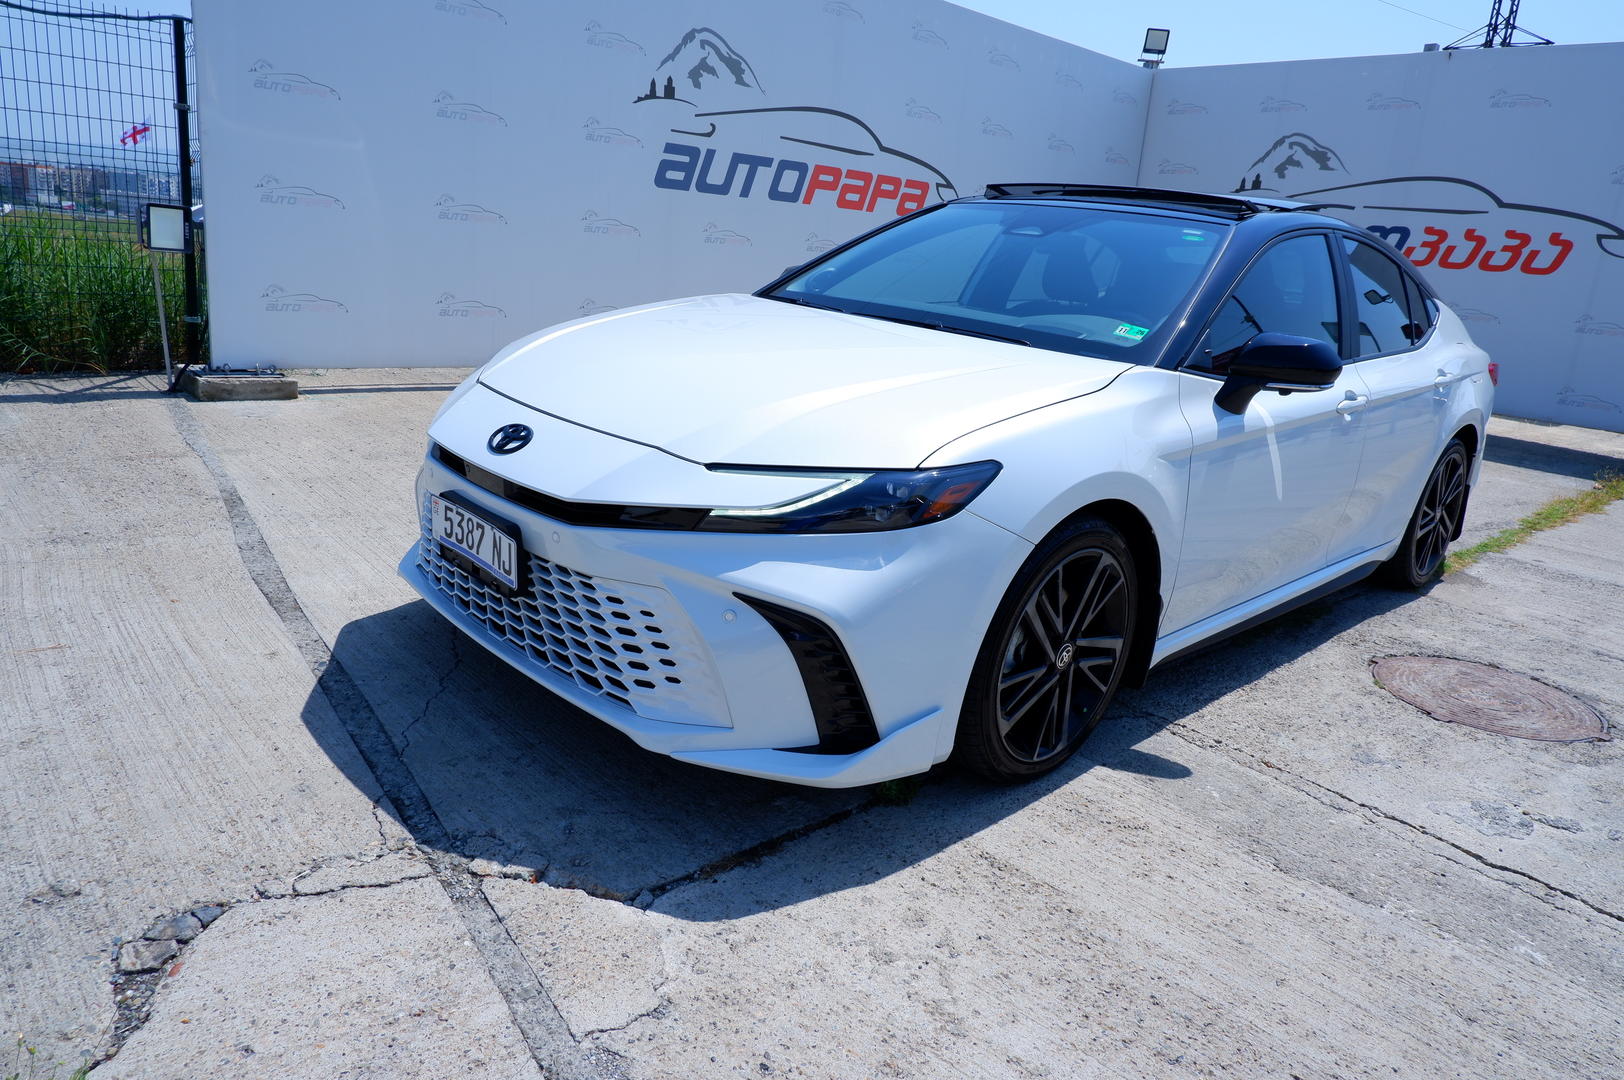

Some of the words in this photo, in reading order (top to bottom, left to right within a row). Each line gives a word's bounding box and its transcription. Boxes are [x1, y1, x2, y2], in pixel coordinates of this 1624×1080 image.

[653, 142, 929, 216] AUTOPAPA
[444, 504, 485, 555] 5387
[491, 530, 512, 577] NJ
